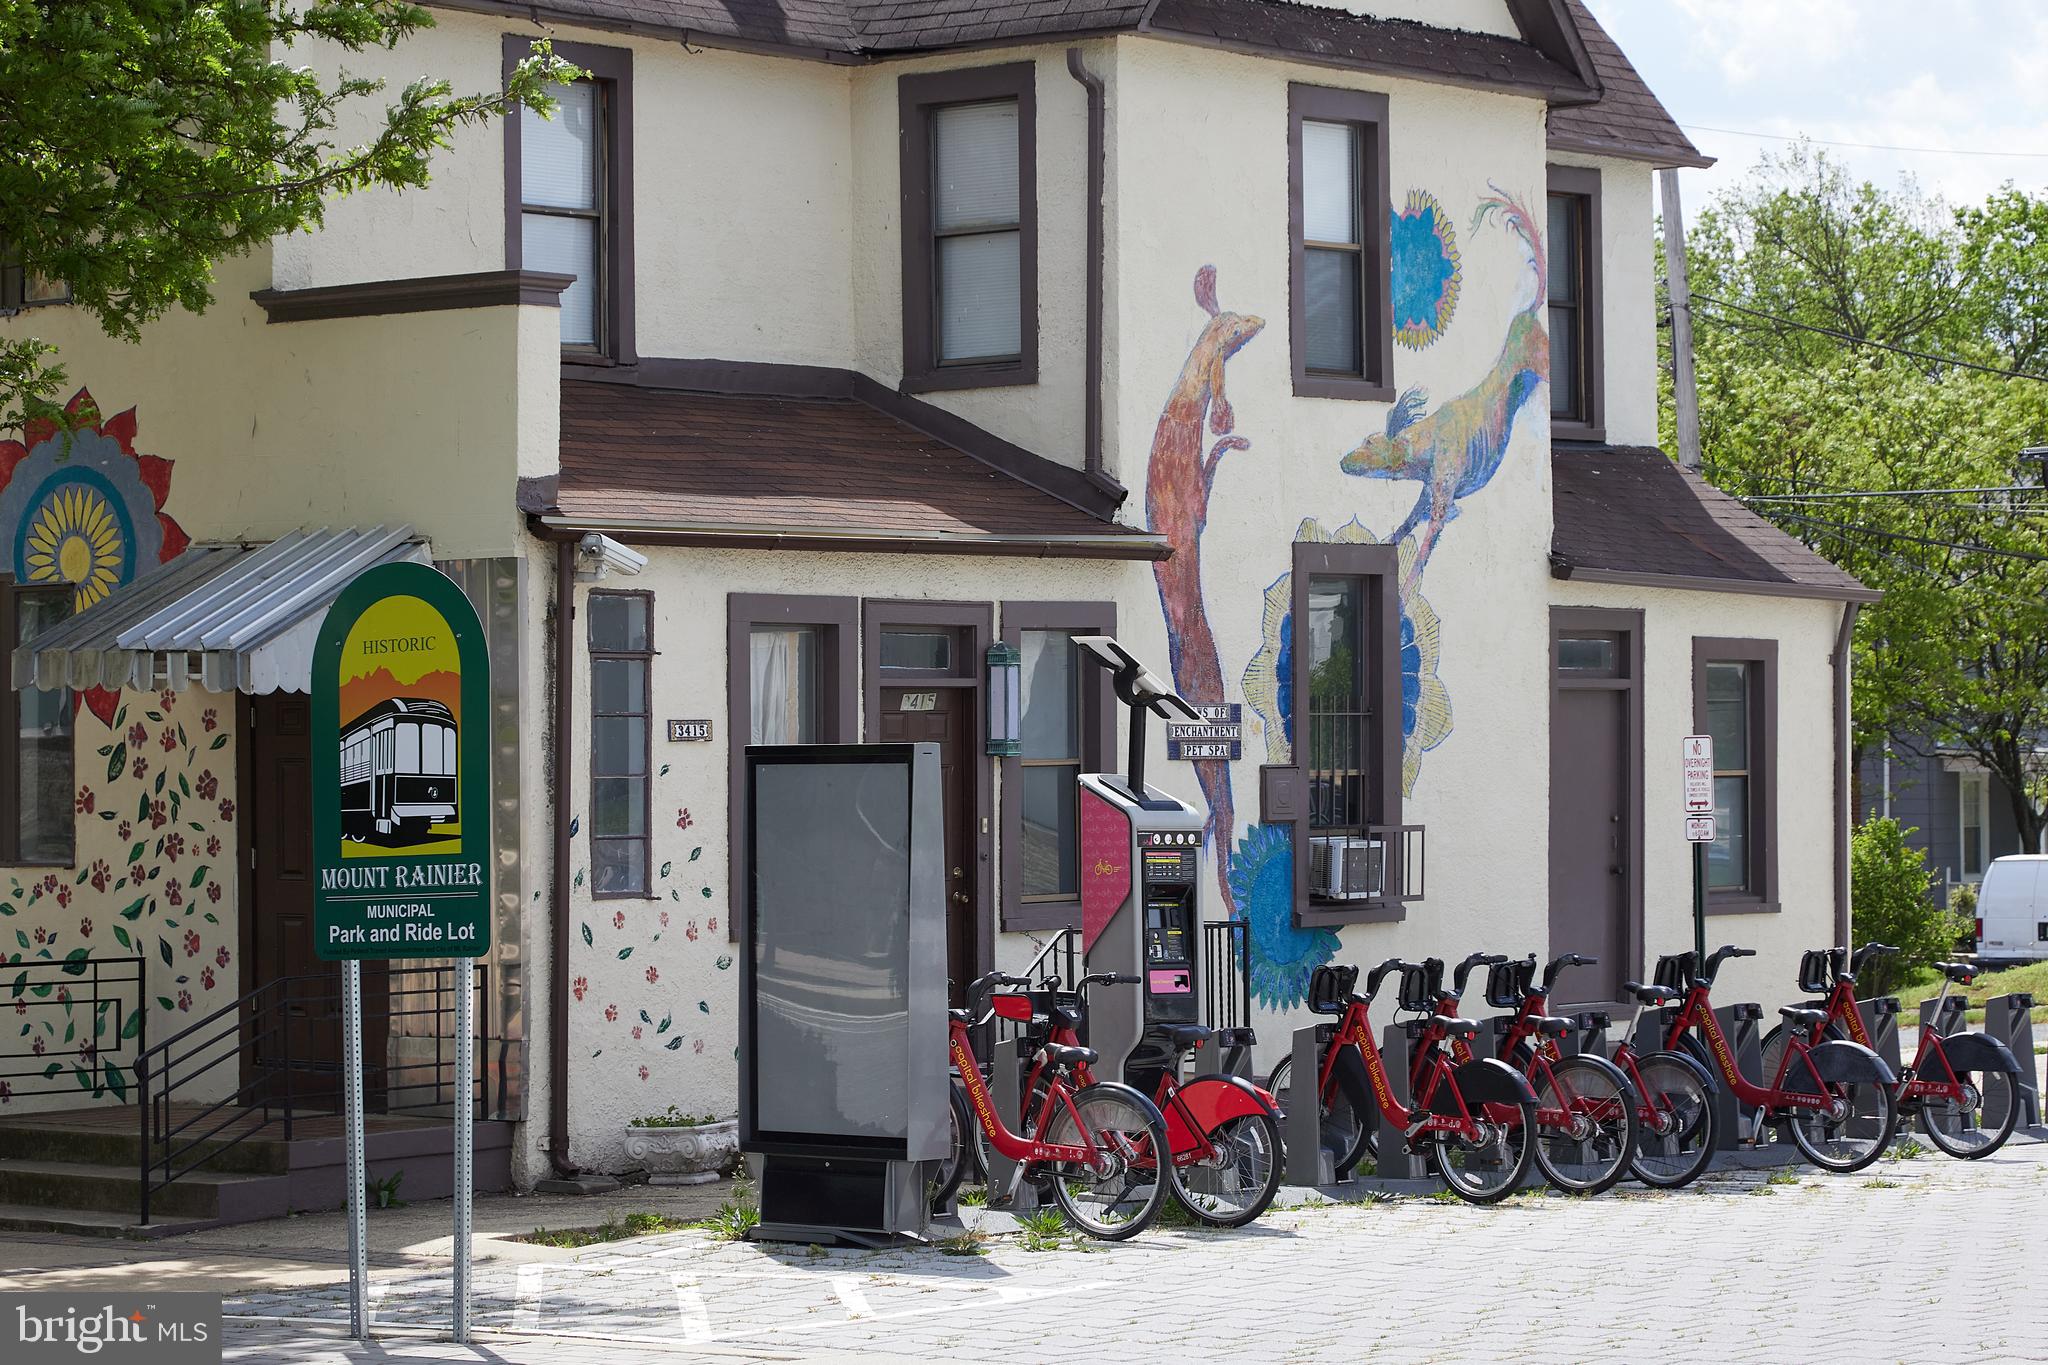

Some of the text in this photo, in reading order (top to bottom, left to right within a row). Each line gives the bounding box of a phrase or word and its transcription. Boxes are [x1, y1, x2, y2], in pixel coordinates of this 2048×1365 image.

[363, 635, 436, 655] HISTORIC
[1215, 707, 1226, 718] OF
[678, 725, 706, 737] 3415
[1174, 726, 1237, 737] ENCHANTMENT
[1186, 745, 1226, 756] PET SPA
[1693, 744, 1701, 755] NO
[1685, 758, 1711, 768] OVERNIGHT
[1687, 770, 1709, 780] PARKING
[321, 863, 483, 890] MOUNT RAINIER
[367, 903, 435, 919] MUNICIPAL
[329, 921, 476, 944] Park and Ride Lot
[1843, 1001, 1862, 1032] capital
[1700, 1007, 1737, 1086] capital bikeshare
[1356, 1025, 1390, 1109] capital bikeshare
[954, 1045, 997, 1138] capital bikeshare
